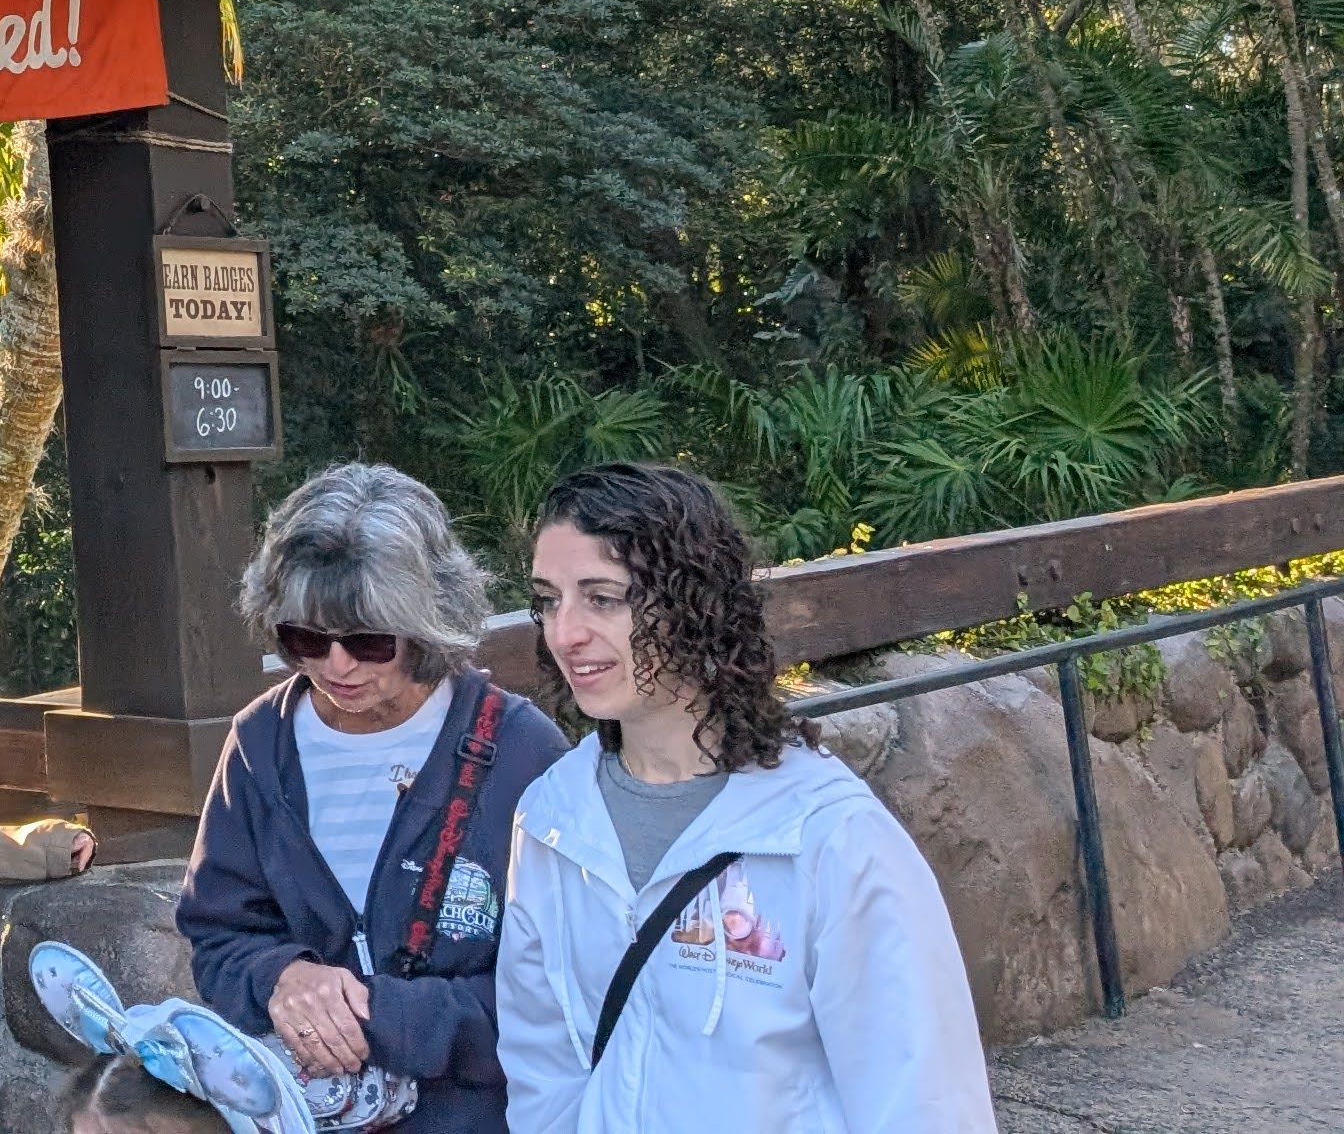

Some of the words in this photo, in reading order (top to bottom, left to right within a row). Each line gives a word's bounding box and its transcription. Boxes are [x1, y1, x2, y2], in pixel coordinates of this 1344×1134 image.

[163, 263, 199, 291] EARN
[203, 265, 255, 293] BADGES
[169, 298, 253, 322] TODAY!
[196, 407, 238, 437] 6:30
[742, 959, 773, 976] World
